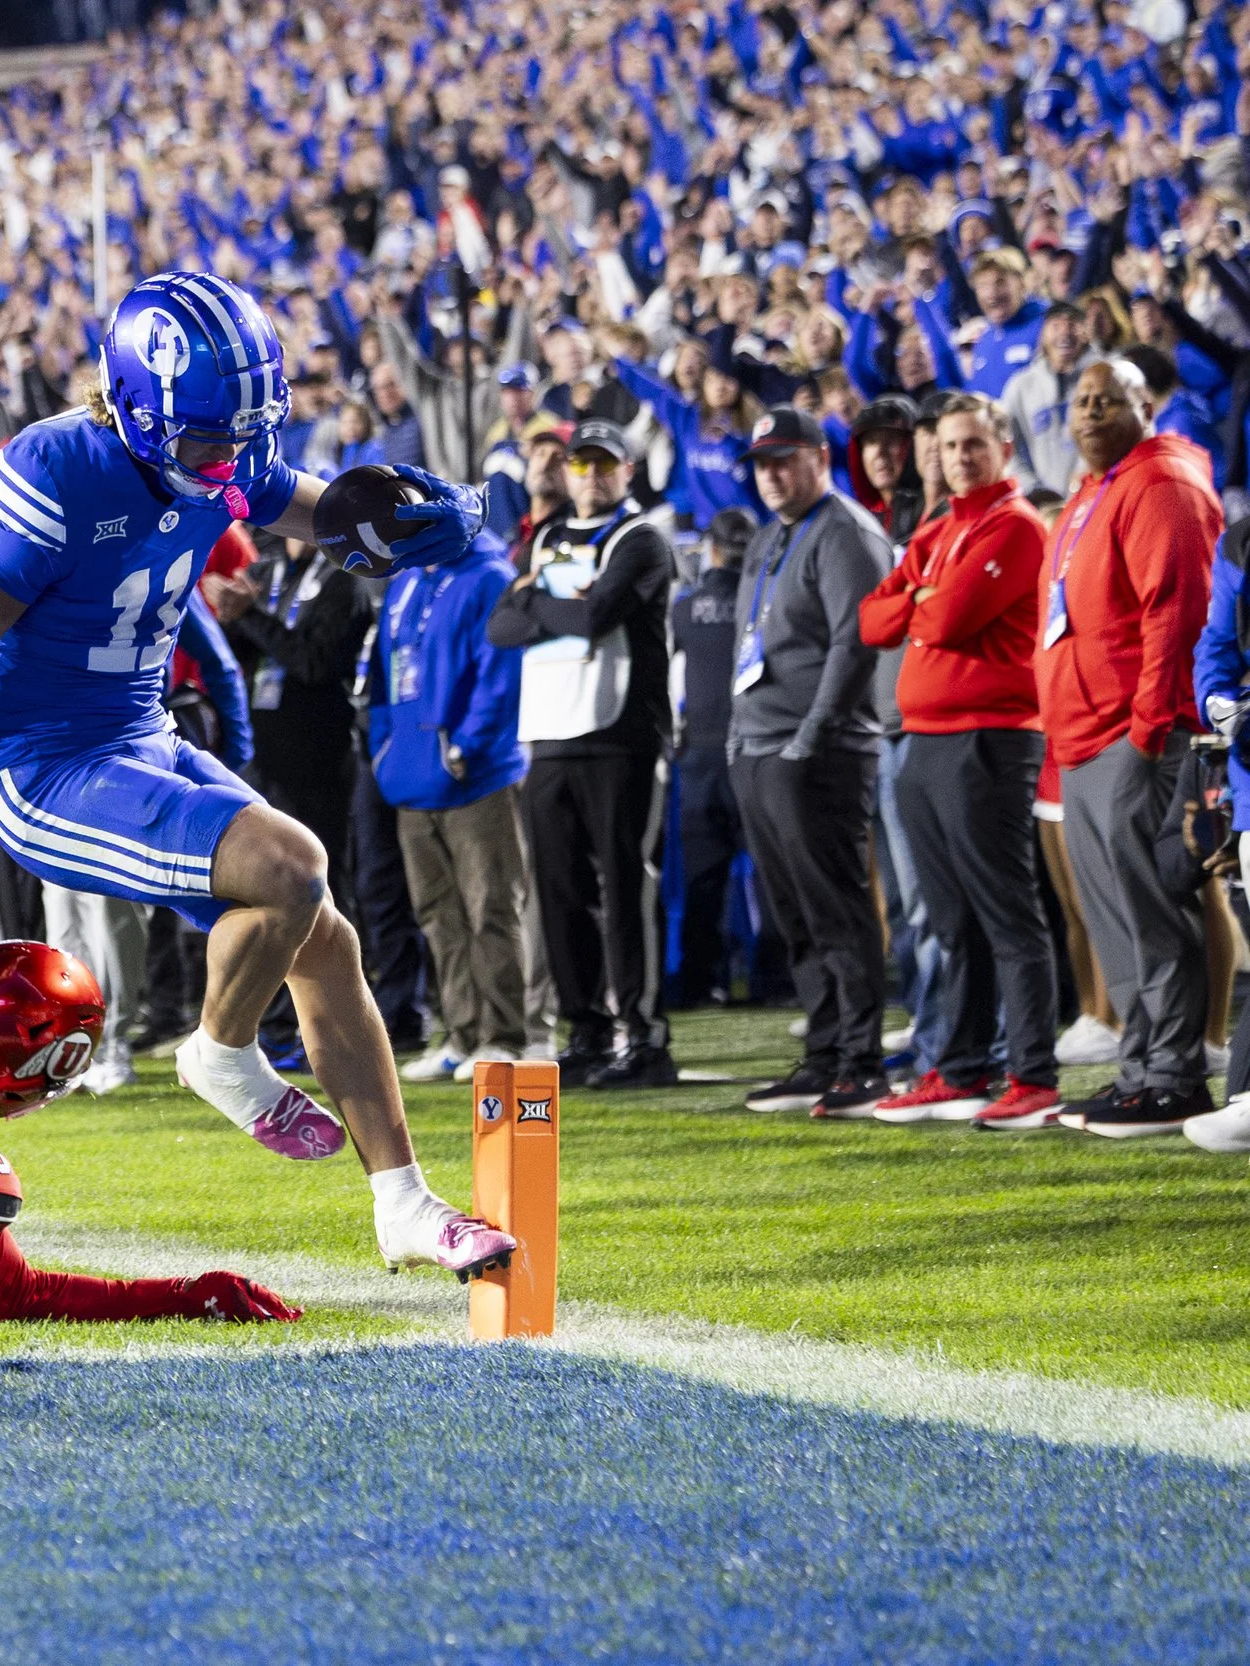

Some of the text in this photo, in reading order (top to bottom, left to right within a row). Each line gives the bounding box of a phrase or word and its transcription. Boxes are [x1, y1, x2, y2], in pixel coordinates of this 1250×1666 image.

[95, 517, 128, 542] XII
[161, 513, 177, 529] Y
[87, 549, 194, 672] 11
[53, 1041, 90, 1076] U
[482, 1098, 499, 1119] Y
[518, 1099, 551, 1122] XII
